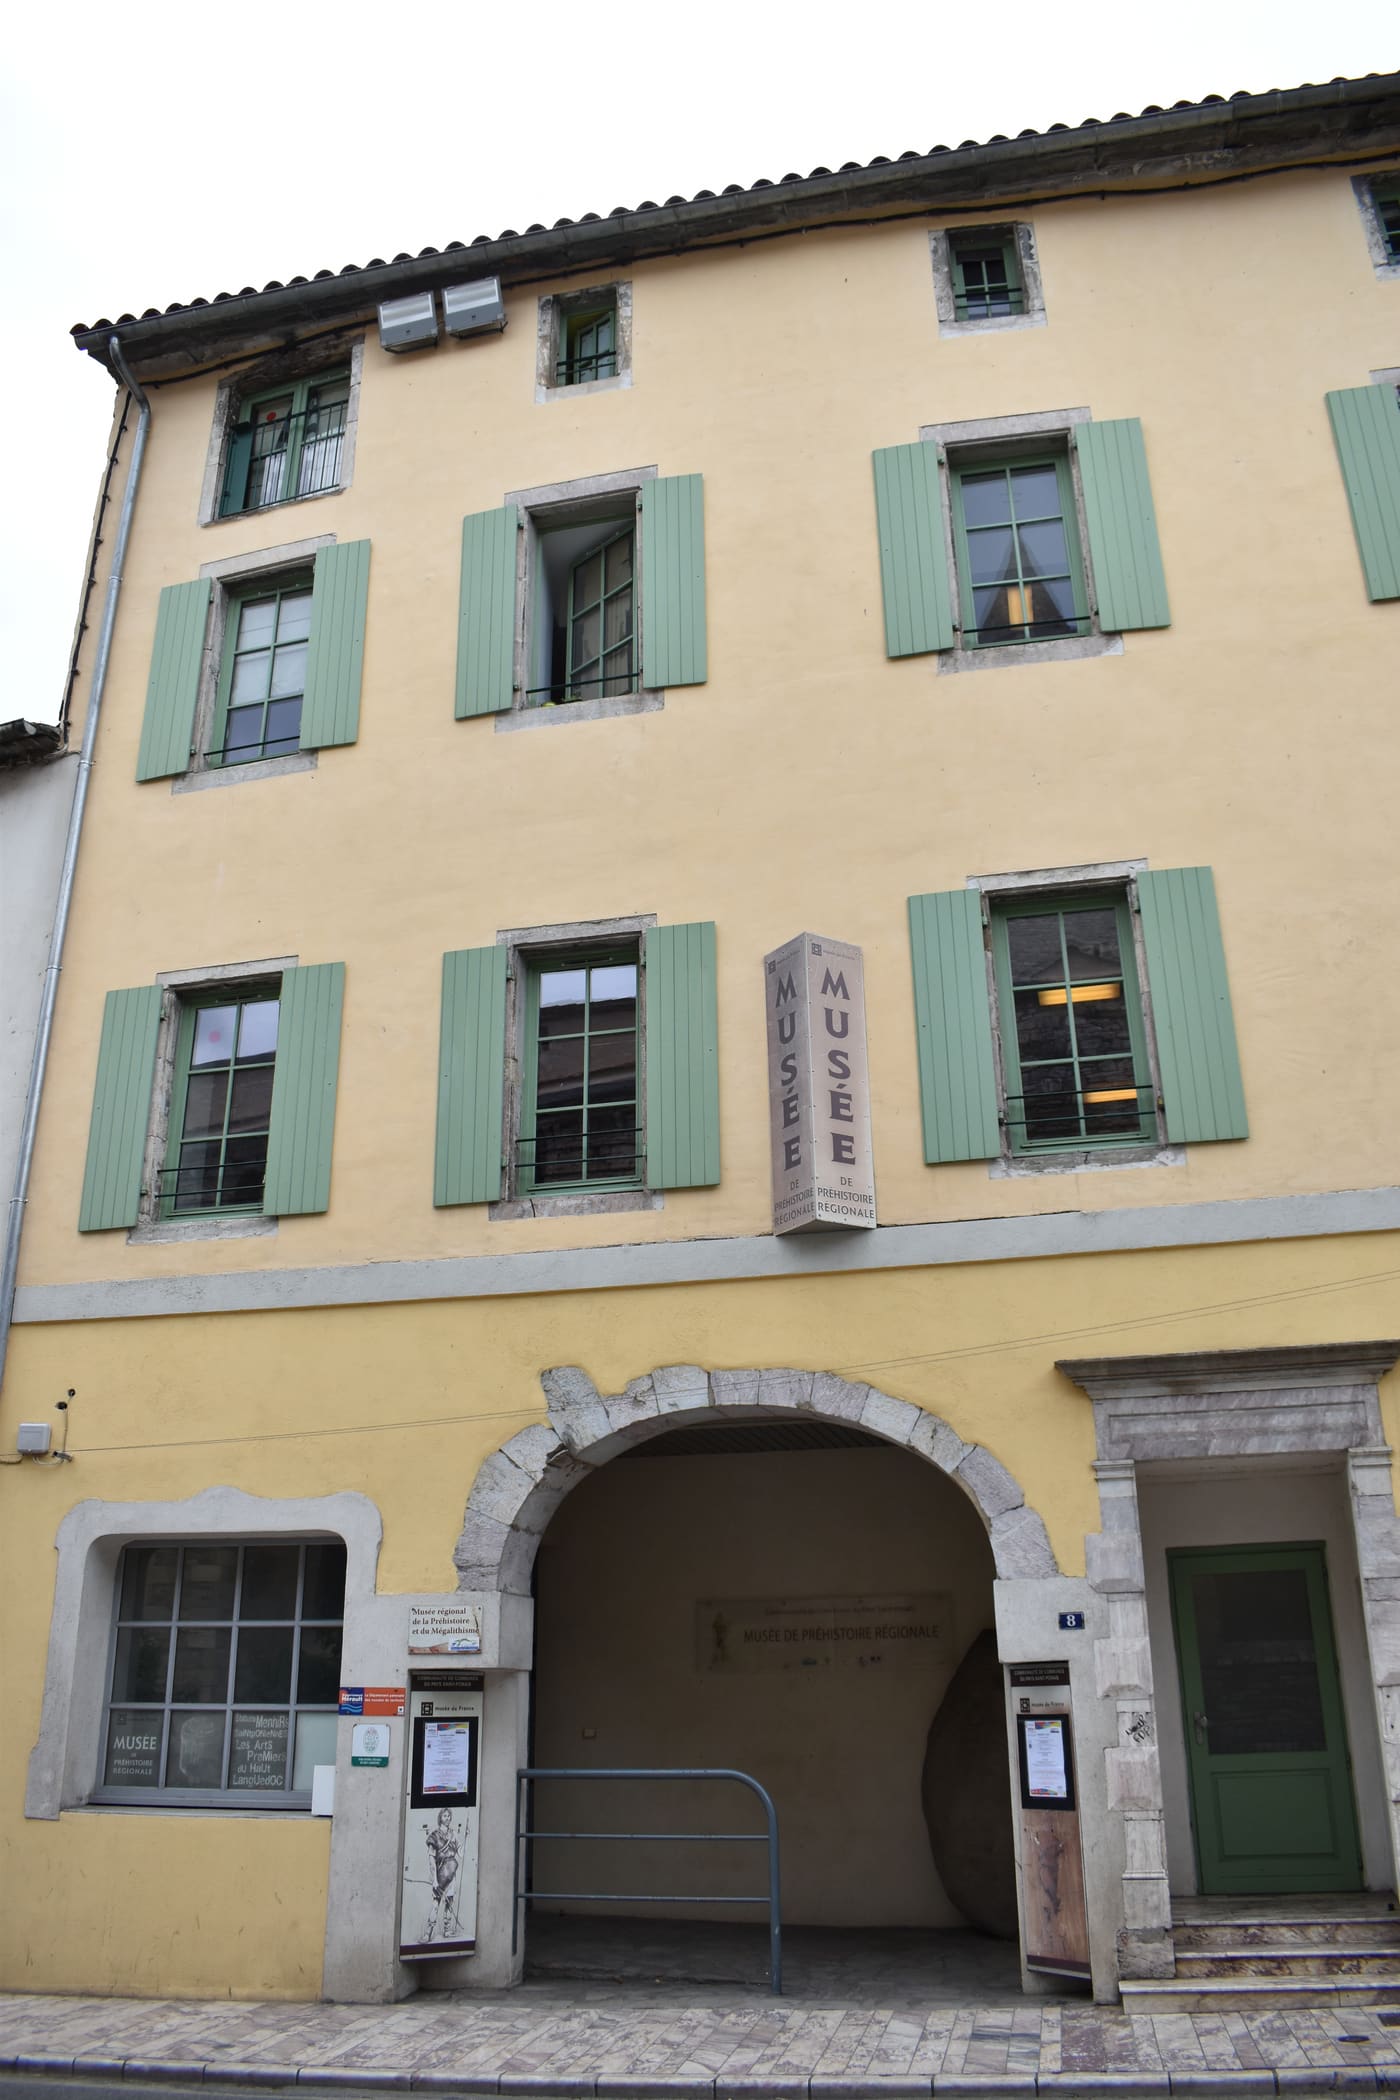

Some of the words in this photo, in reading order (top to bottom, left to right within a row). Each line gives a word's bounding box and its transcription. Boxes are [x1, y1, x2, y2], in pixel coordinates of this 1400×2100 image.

[775, 970, 801, 1172] MUSÉE
[820, 967, 857, 1166] MUSÉE
[790, 1179, 799, 1191] DE
[840, 1176, 853, 1187] DE
[412, 1607, 436, 1616] Musée
[437, 1607, 467, 1617] régional
[430, 1617, 470, 1625] Préhistoire
[1066, 1615, 1076, 1627] 8
[420, 1627, 430, 1635] du
[430, 1626, 480, 1637] Mégalithisme
[743, 1626, 780, 1643] MUSÉE
[784, 1628, 798, 1642] DE
[113, 1732, 157, 1750] MUSÉE
